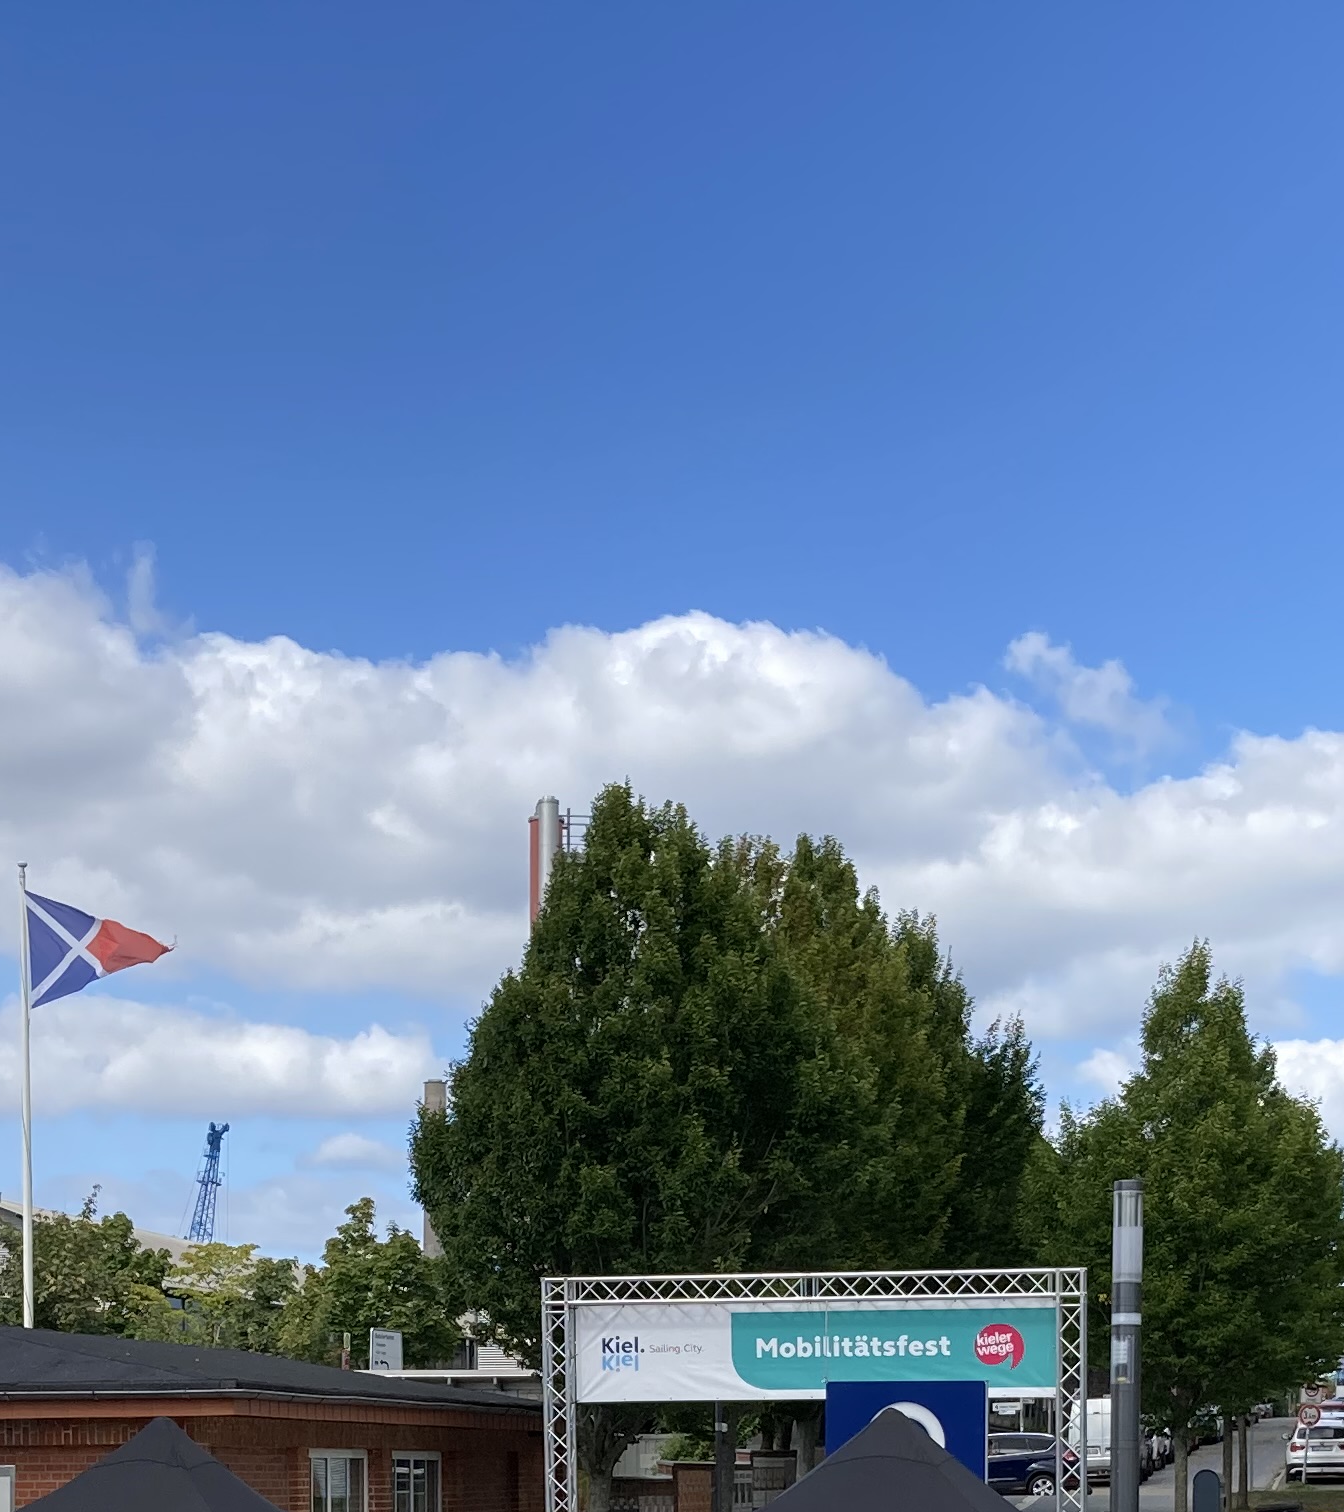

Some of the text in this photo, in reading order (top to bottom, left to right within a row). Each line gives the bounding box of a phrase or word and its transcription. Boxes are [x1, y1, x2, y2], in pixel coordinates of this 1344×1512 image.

[601, 1335, 645, 1354] Kiel.
[975, 1331, 1013, 1345] kieler
[756, 1335, 951, 1359] Mobilitätsfest
[977, 1343, 1014, 1357] wege
